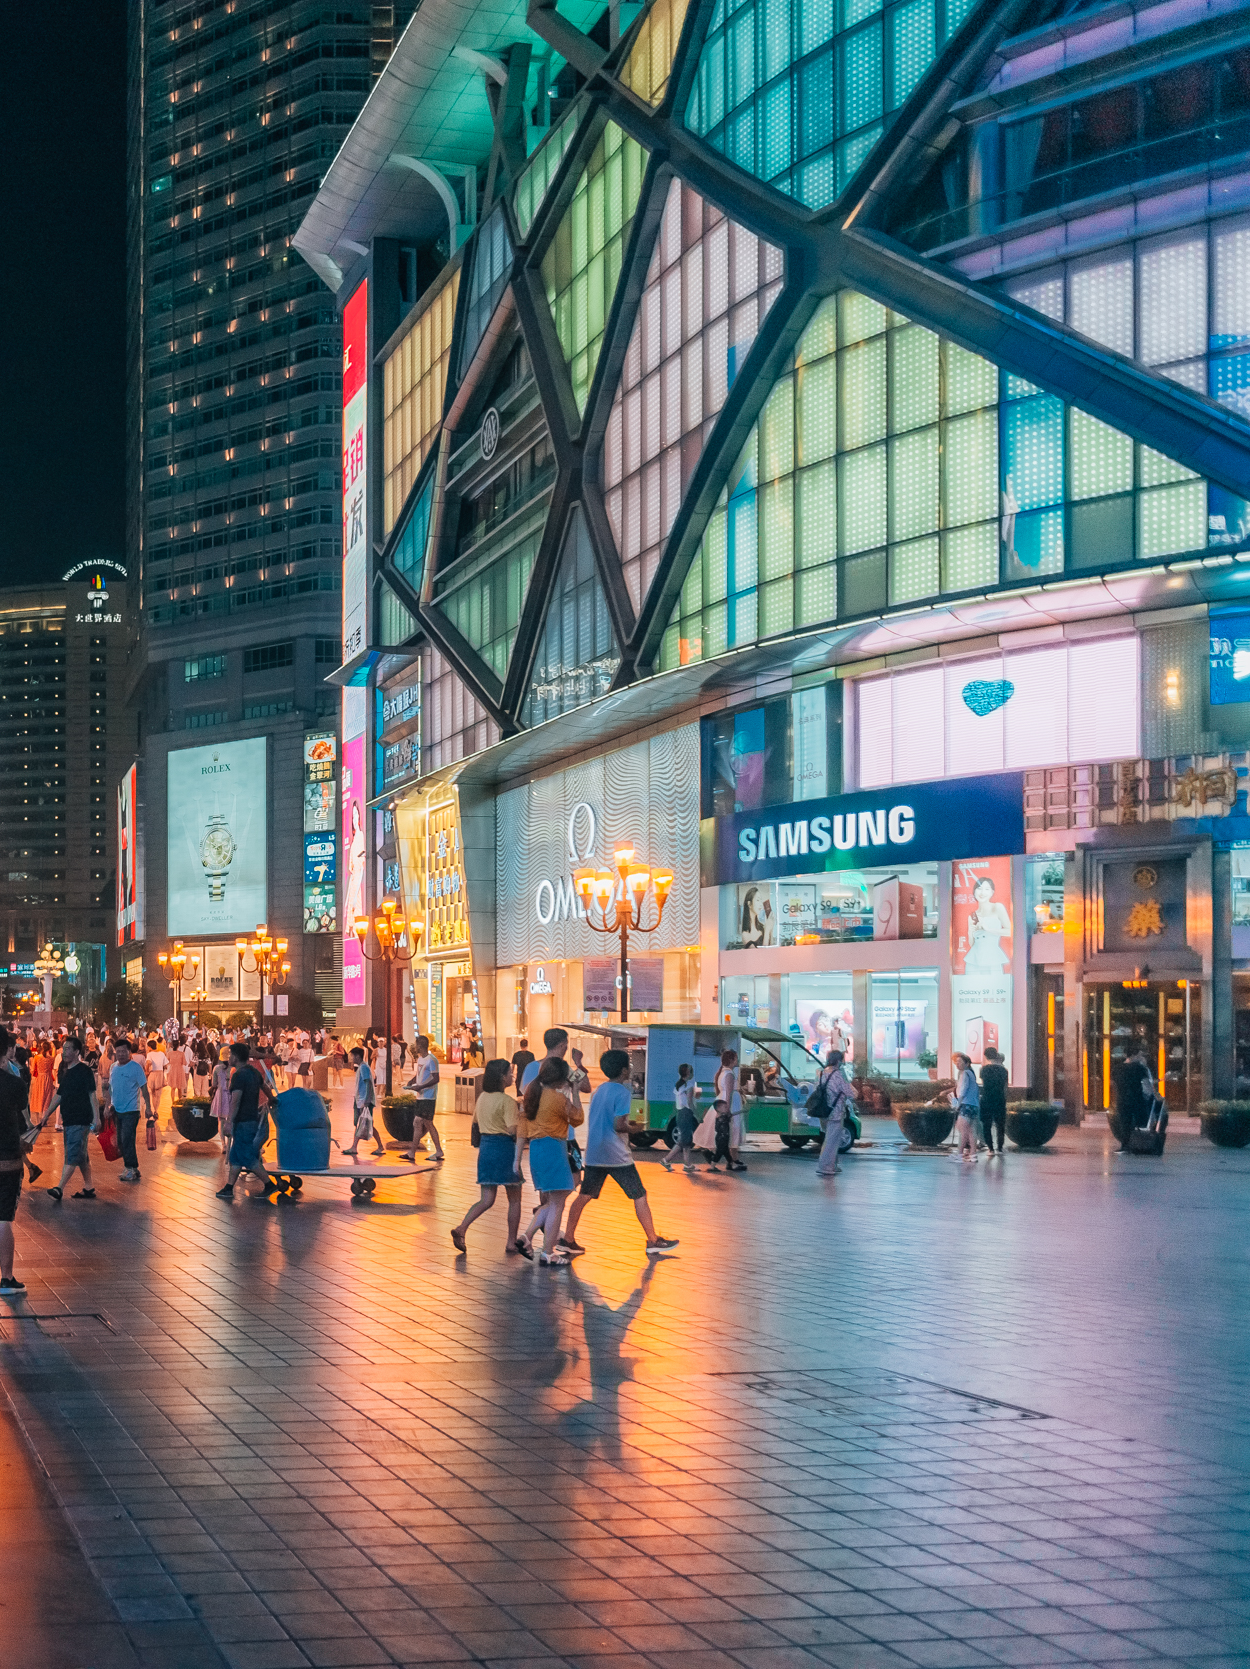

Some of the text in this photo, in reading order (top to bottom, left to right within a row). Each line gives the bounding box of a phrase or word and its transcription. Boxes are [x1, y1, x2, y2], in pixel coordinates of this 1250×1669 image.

[75, 613, 122, 623] 大世界酒店
[201, 763, 231, 775] ROLEX
[797, 770, 823, 782] OMEGA
[738, 805, 916, 862] SAMSUNG
[959, 861, 990, 869] SAMSUNG
[782, 902, 818, 914] Galaxy
[820, 899, 832, 911] S9
[211, 976, 234, 984] ROLEX
[530, 981, 552, 995] OMEGA
[874, 1005, 896, 1014] Galaxy
